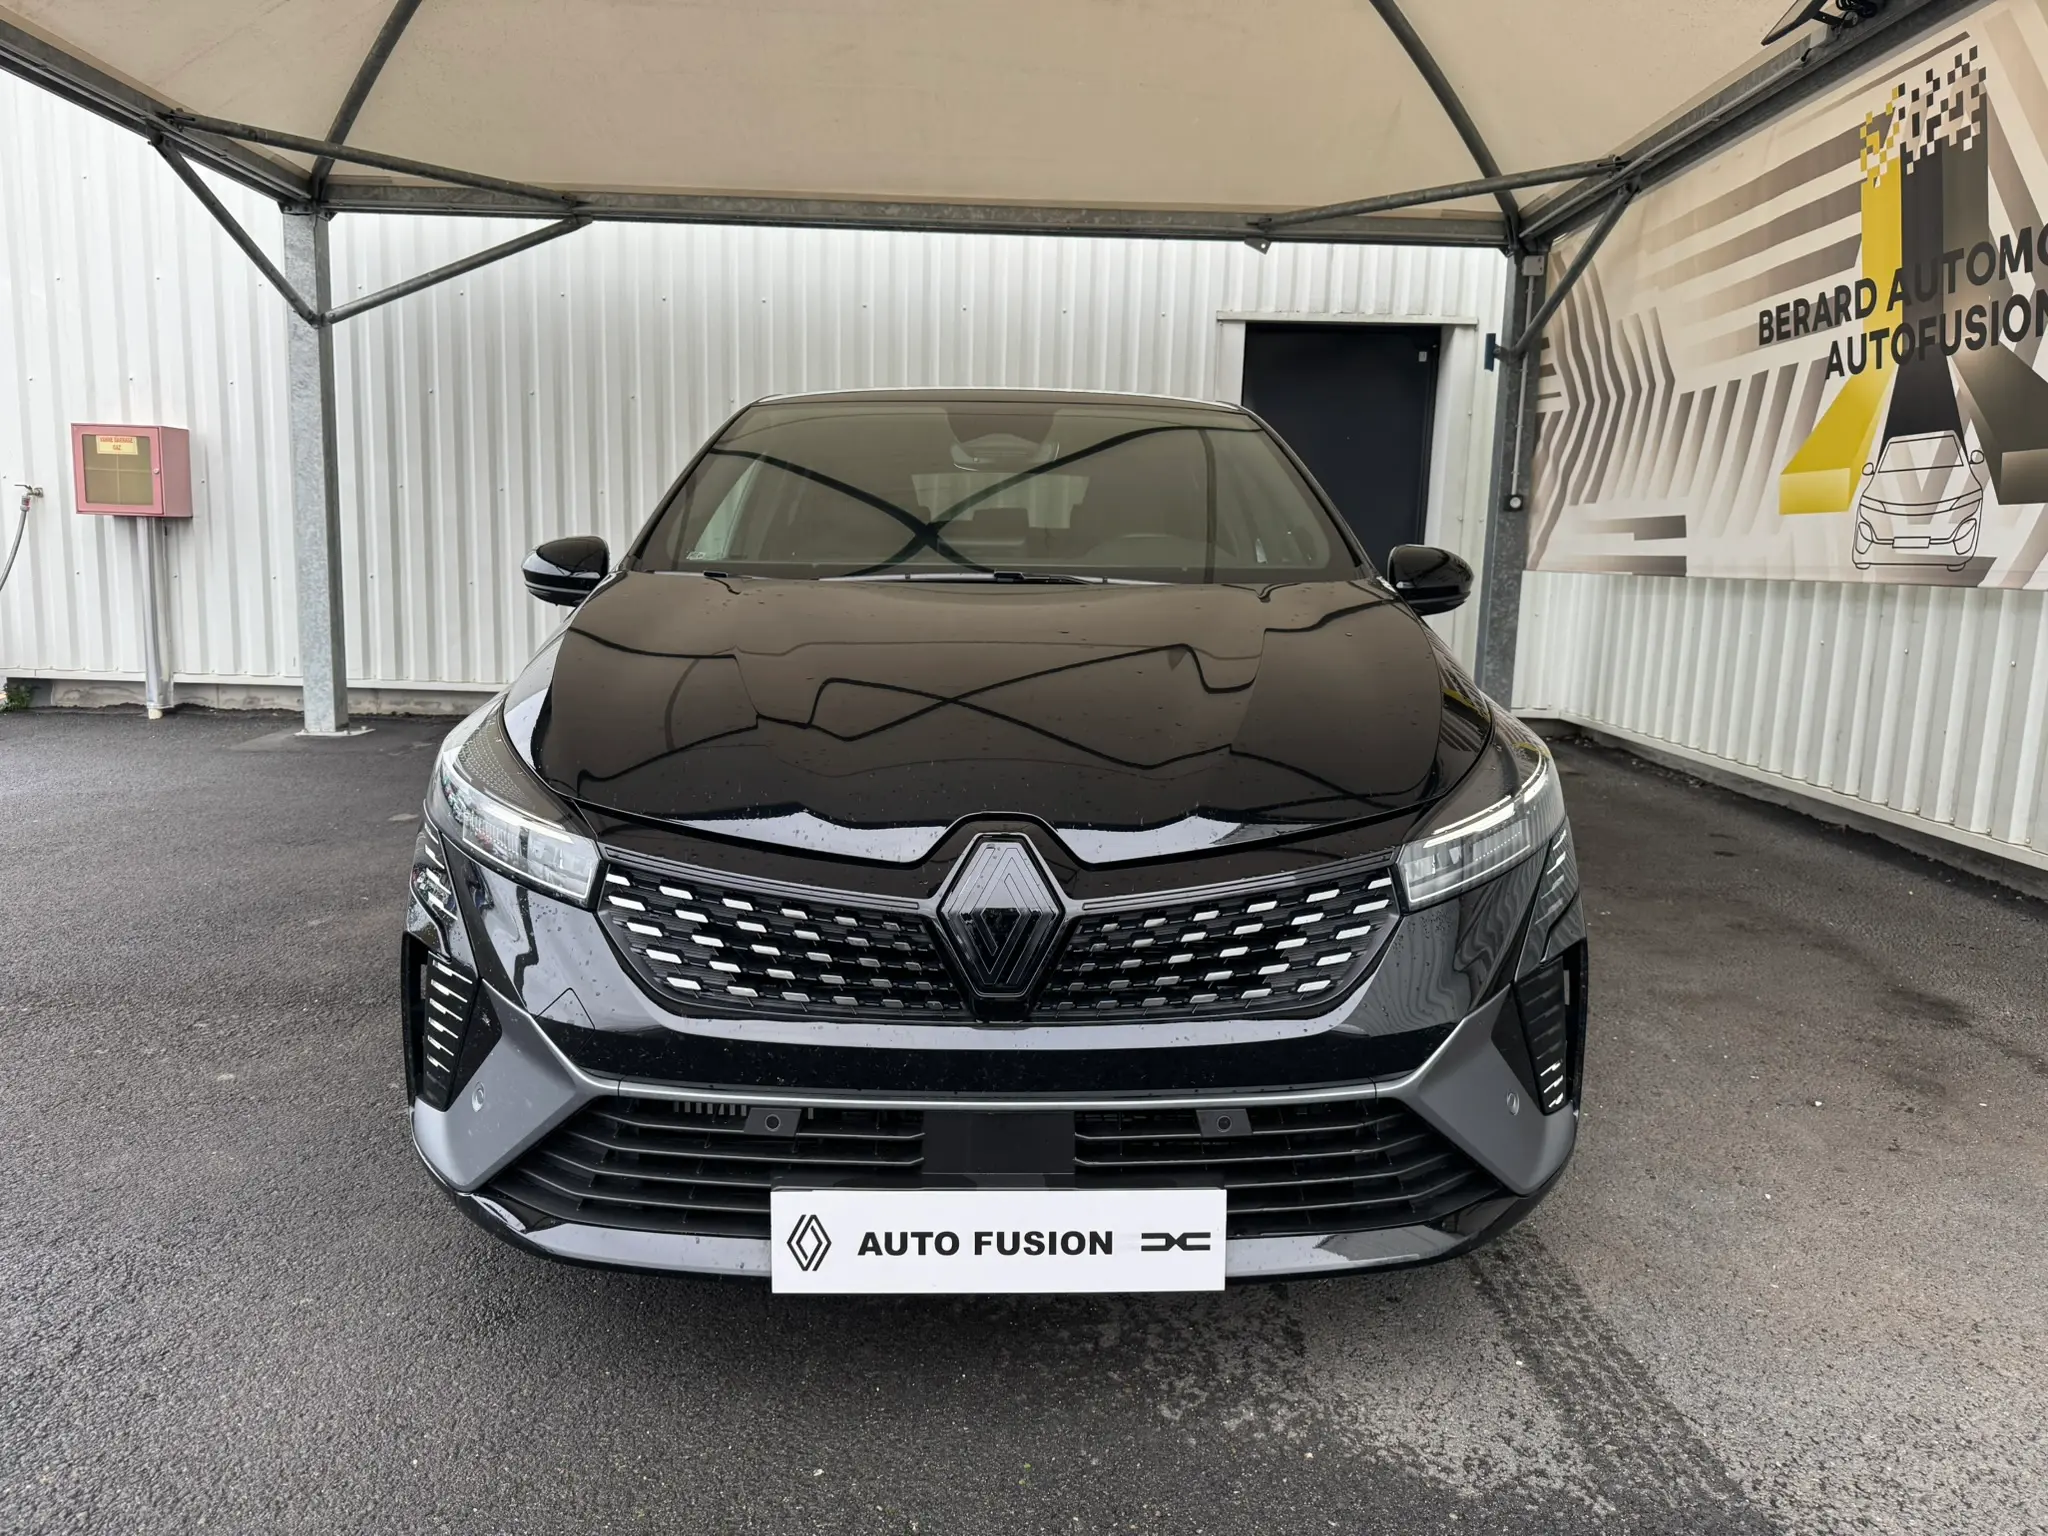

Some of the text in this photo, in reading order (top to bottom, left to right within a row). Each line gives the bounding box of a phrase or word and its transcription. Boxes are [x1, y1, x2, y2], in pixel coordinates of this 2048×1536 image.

[1759, 277, 1877, 346] BERARD
[858, 1231, 1113, 1256] AUTO FUSION
